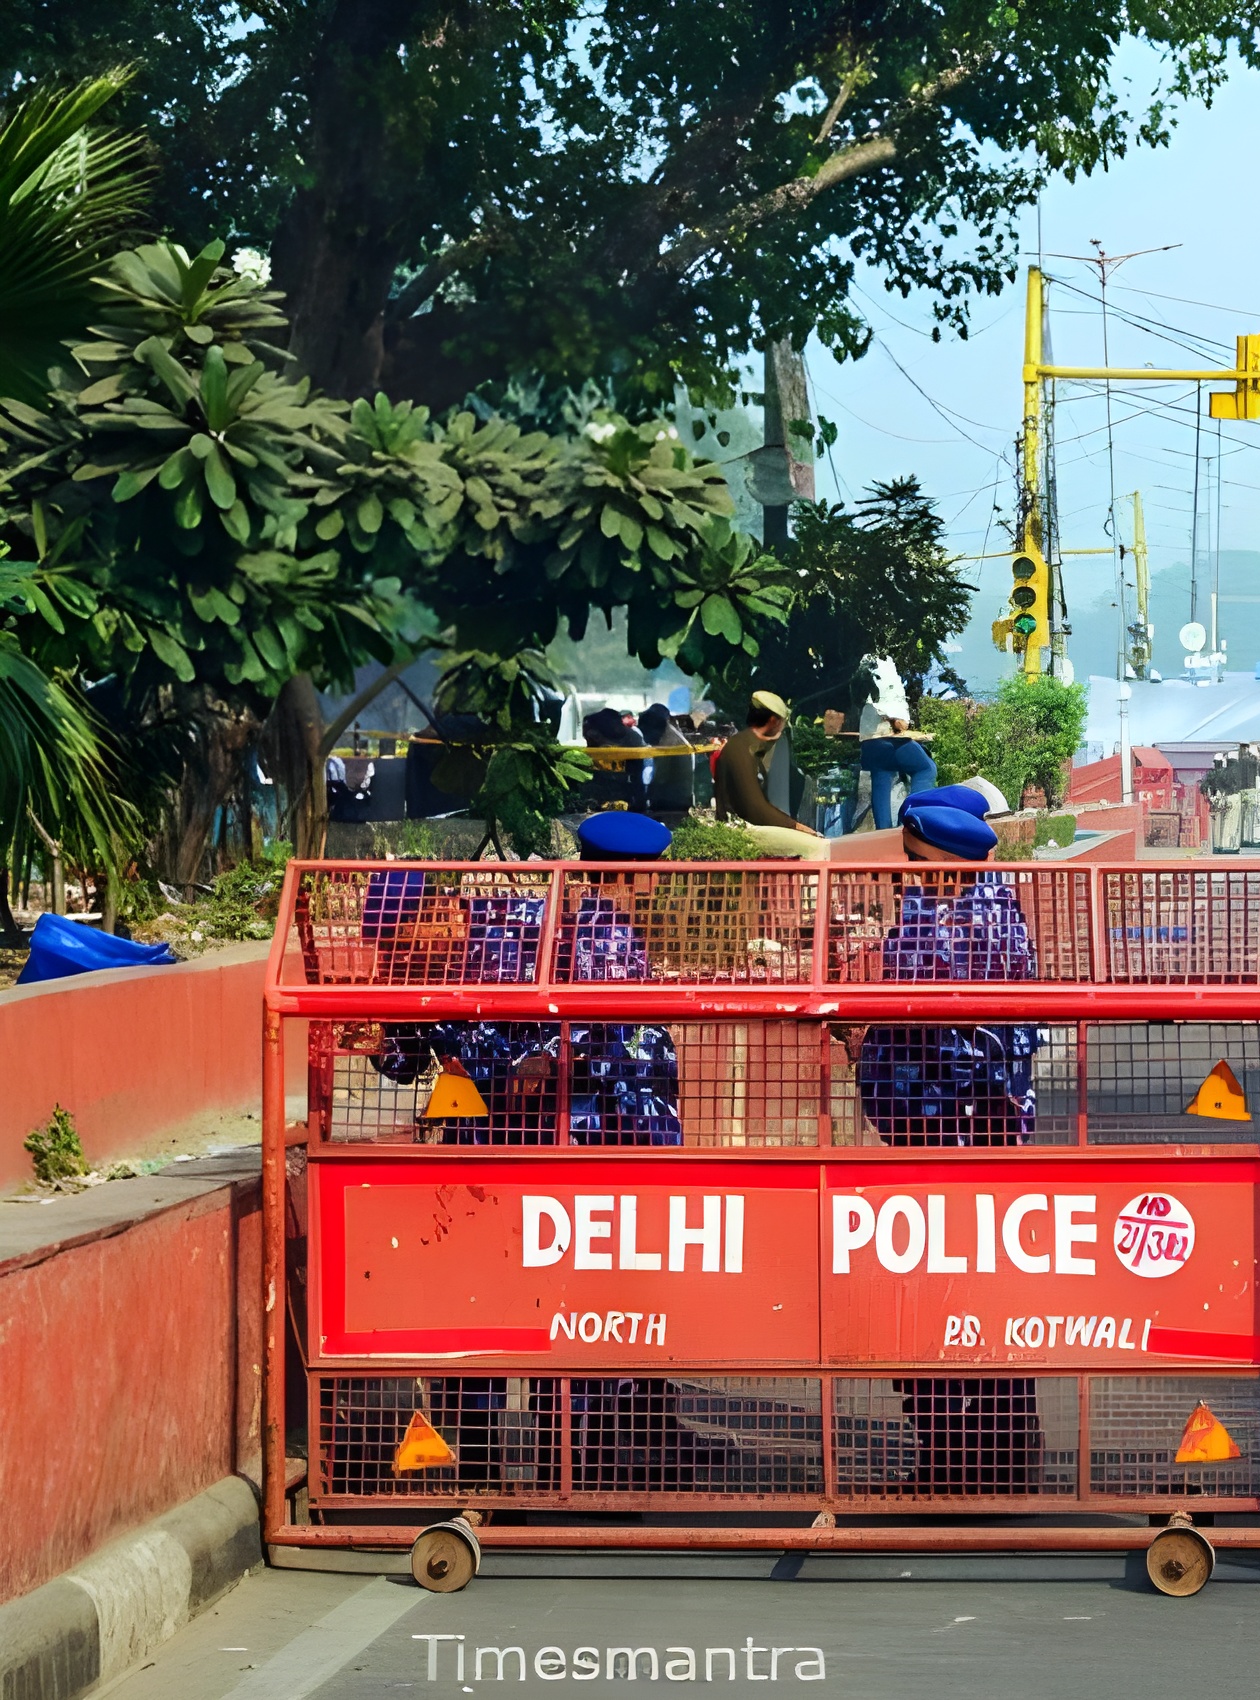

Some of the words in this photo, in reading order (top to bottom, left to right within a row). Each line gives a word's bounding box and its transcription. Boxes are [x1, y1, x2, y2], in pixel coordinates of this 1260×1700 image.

[522, 1194, 744, 1274] DELHI
[832, 1193, 1097, 1276] POLICE
[550, 1312, 666, 1346] NORTH
[1004, 1315, 1151, 1352] KOTWALI
